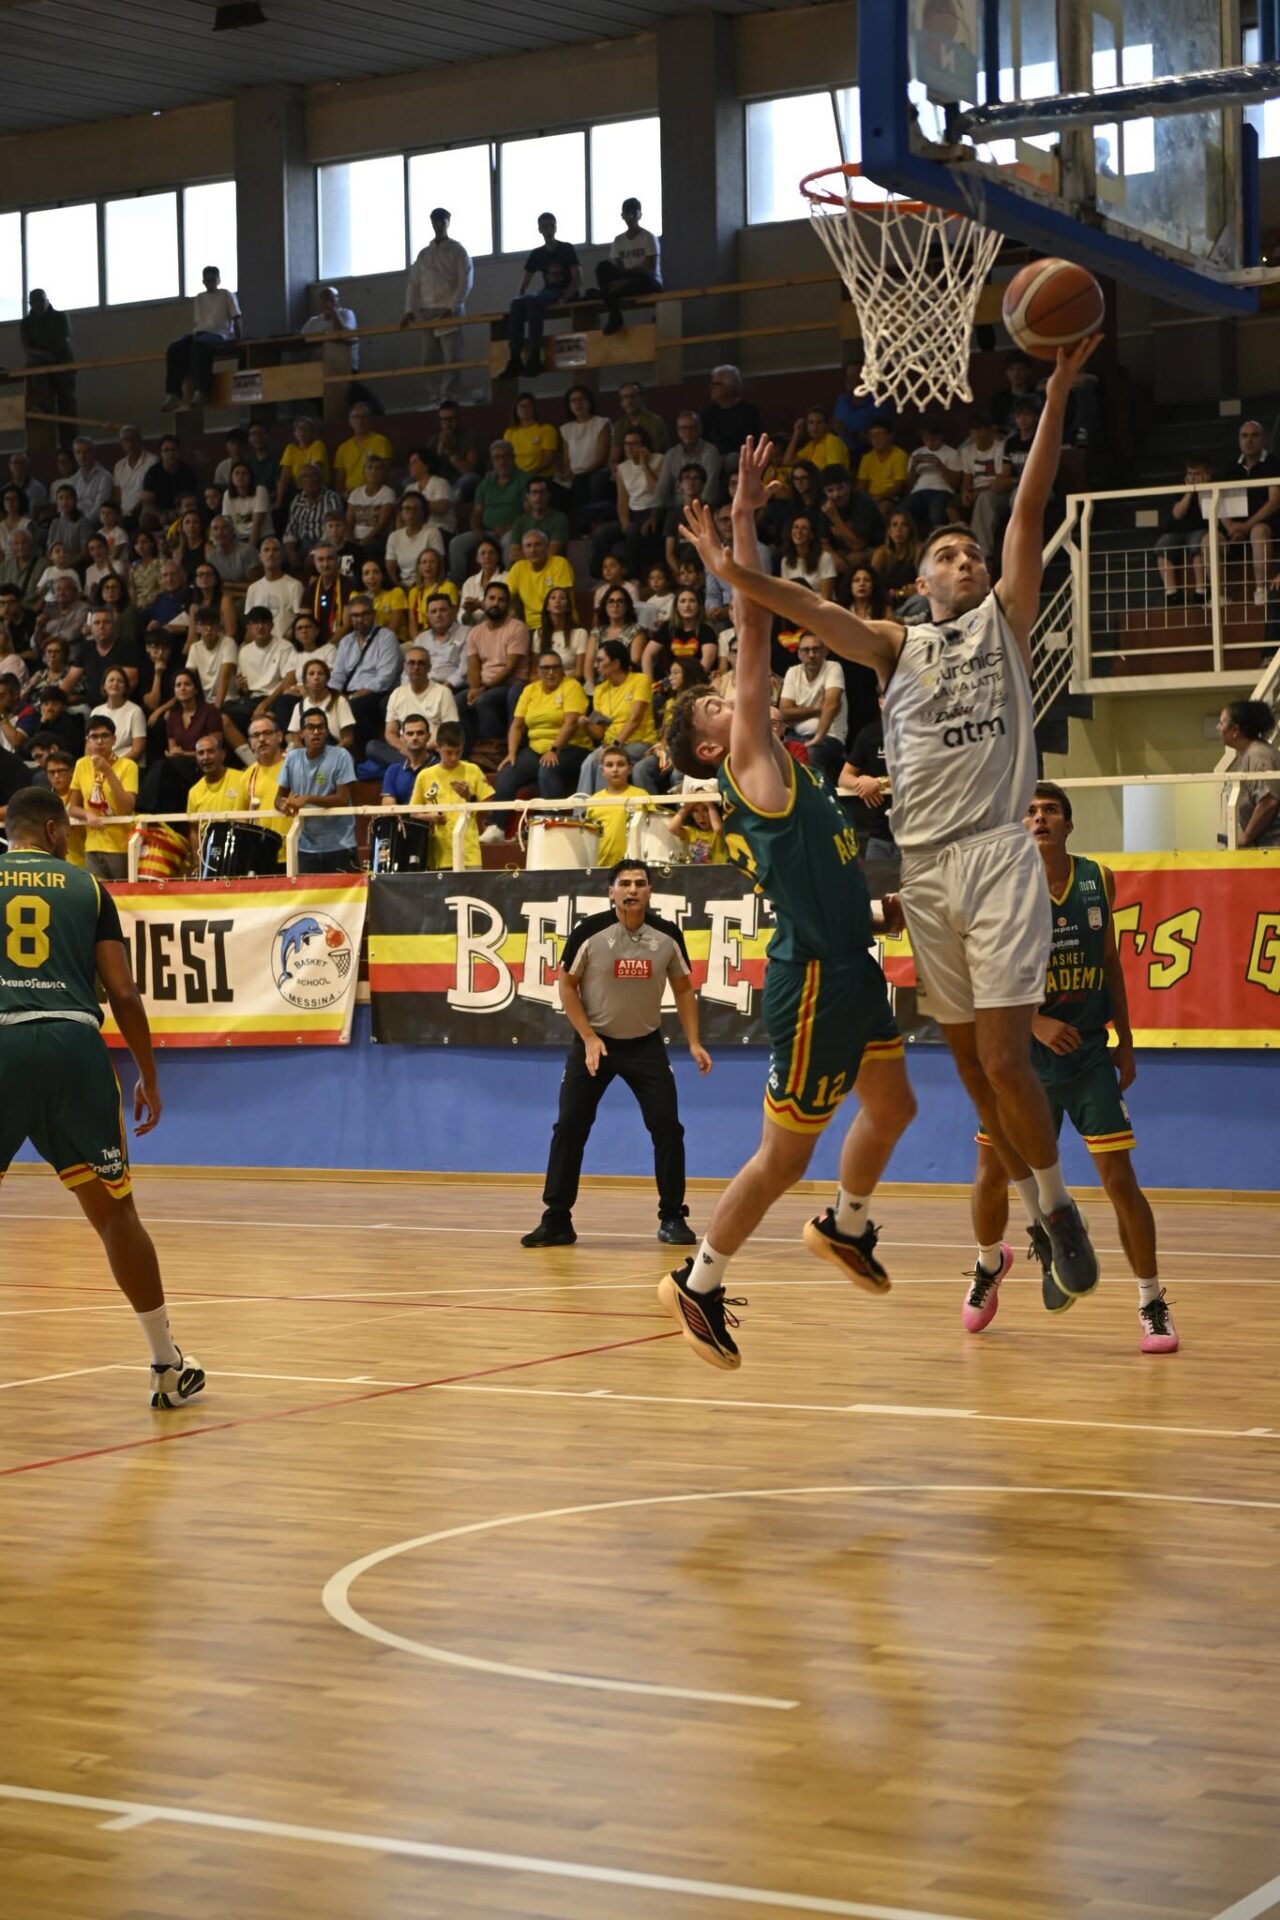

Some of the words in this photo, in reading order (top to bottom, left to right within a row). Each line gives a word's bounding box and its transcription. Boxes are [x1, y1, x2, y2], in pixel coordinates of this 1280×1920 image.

[943, 716, 1006, 748] atm
[6, 894, 51, 969] 8
[294, 958, 329, 970] BASKET
[618, 960, 649, 969] ATTAL
[1051, 951, 1086, 968] ASKET
[617, 968, 649, 976] GROUP
[288, 992, 336, 1008] MESSINA
[811, 1071, 850, 1108] 12
